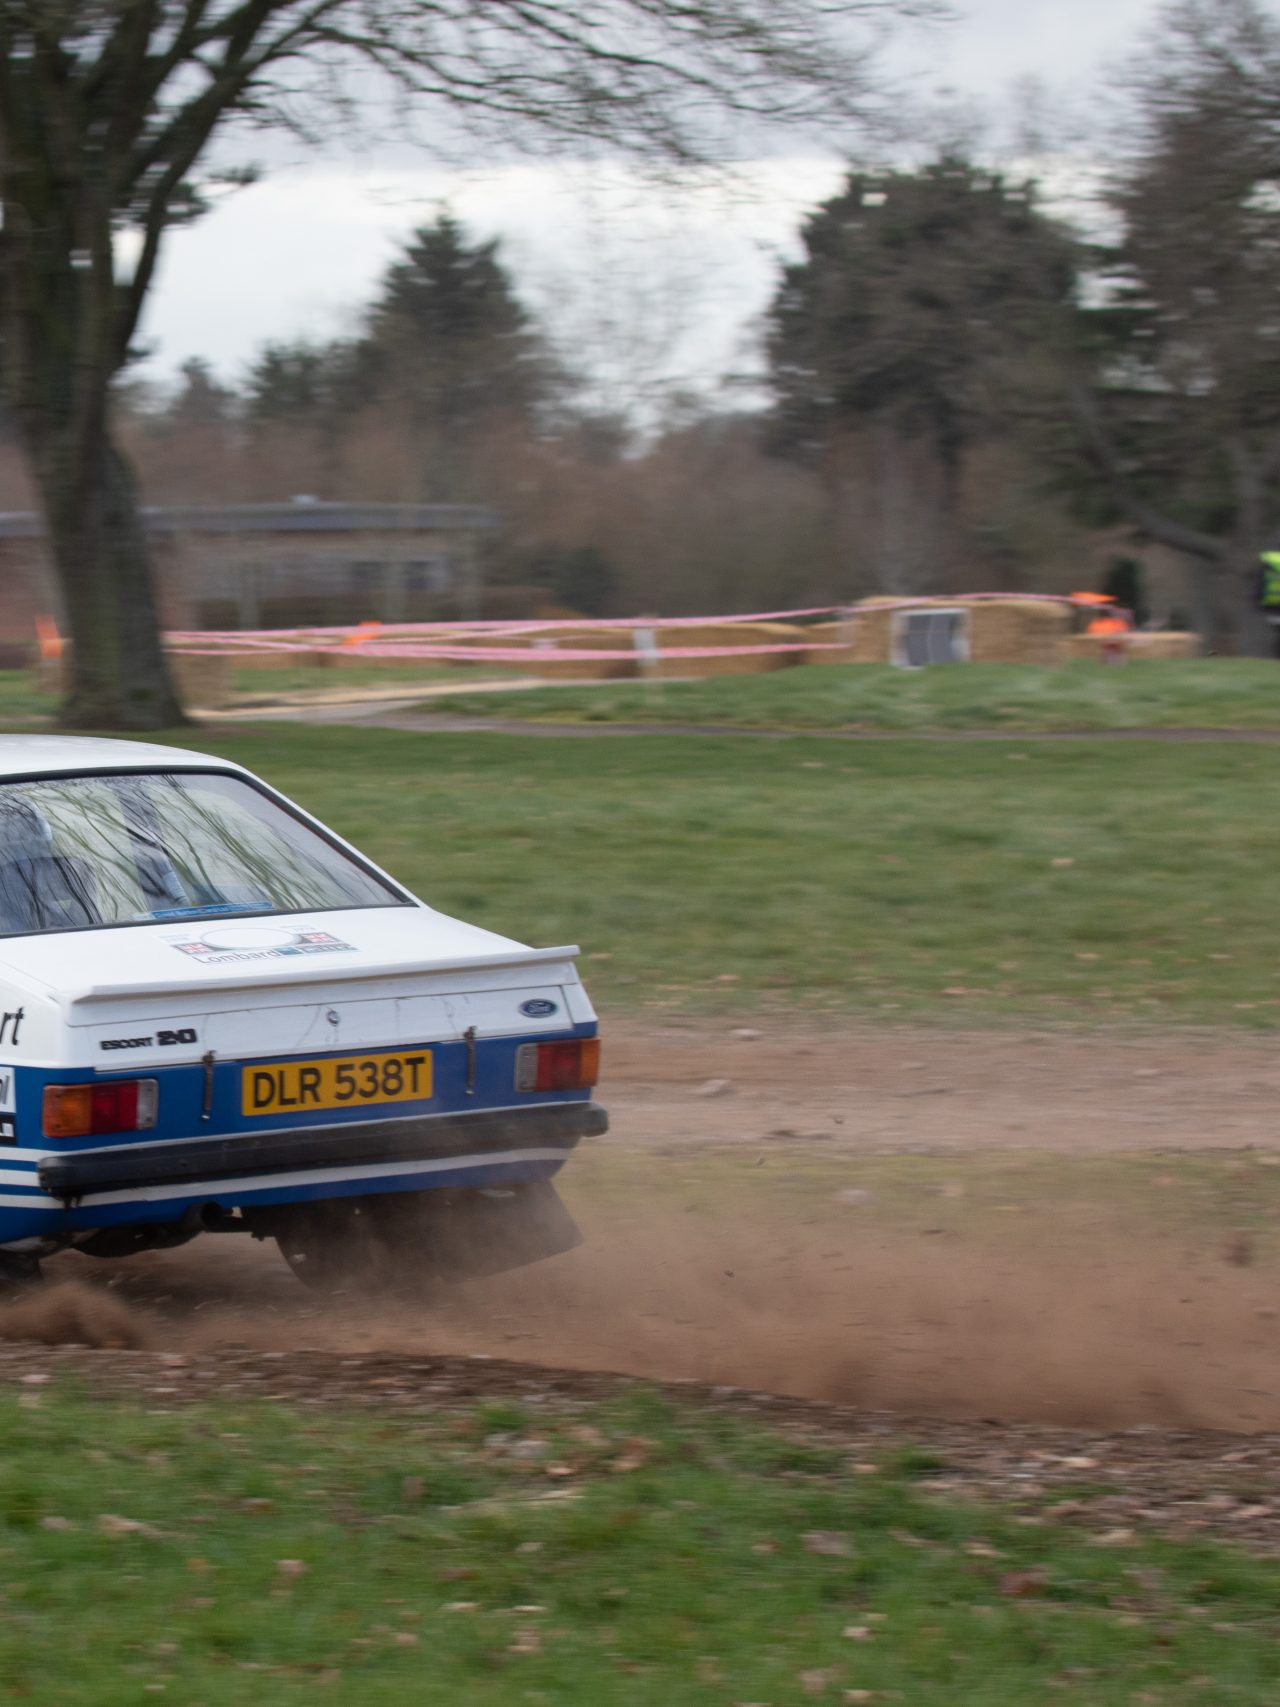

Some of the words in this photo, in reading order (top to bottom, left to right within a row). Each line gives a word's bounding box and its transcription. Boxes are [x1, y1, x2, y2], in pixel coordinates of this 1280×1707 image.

[192, 947, 282, 964] Lombard
[100, 1037, 153, 1051] ESCORT
[253, 1066, 321, 1108] DLR
[334, 1056, 426, 1101] 538T
